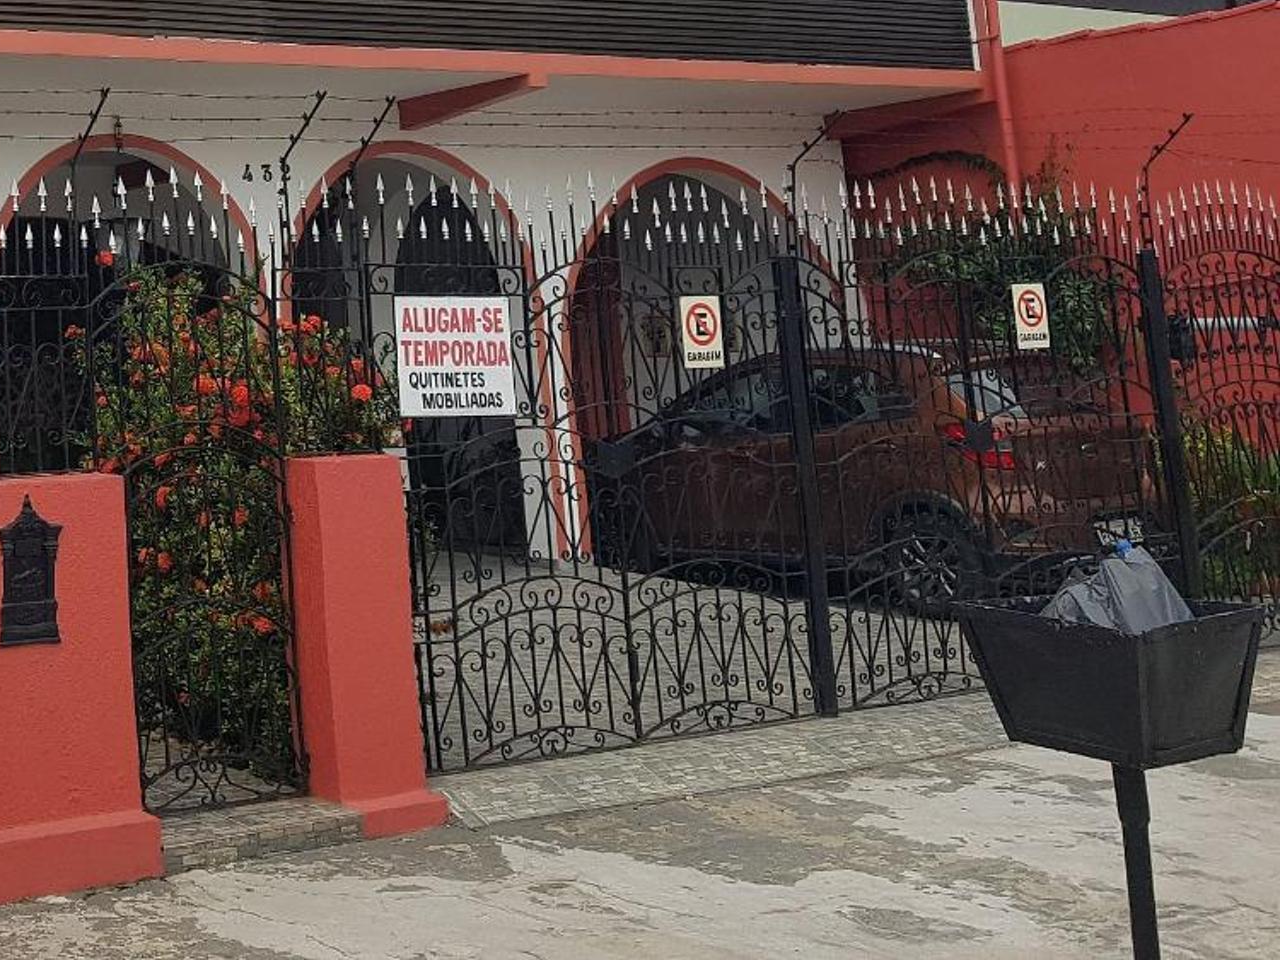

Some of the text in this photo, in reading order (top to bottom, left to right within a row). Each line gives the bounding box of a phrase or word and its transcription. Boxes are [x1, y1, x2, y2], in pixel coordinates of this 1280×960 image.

[242, 164, 291, 182] 432
[402, 307, 504, 333] ALUGAM-SE
[401, 340, 509, 367] TEMPORADA
[687, 351, 721, 362] GARAGEM
[409, 372, 485, 389] QUITINETES
[422, 392, 504, 409] MOBILIADAS
